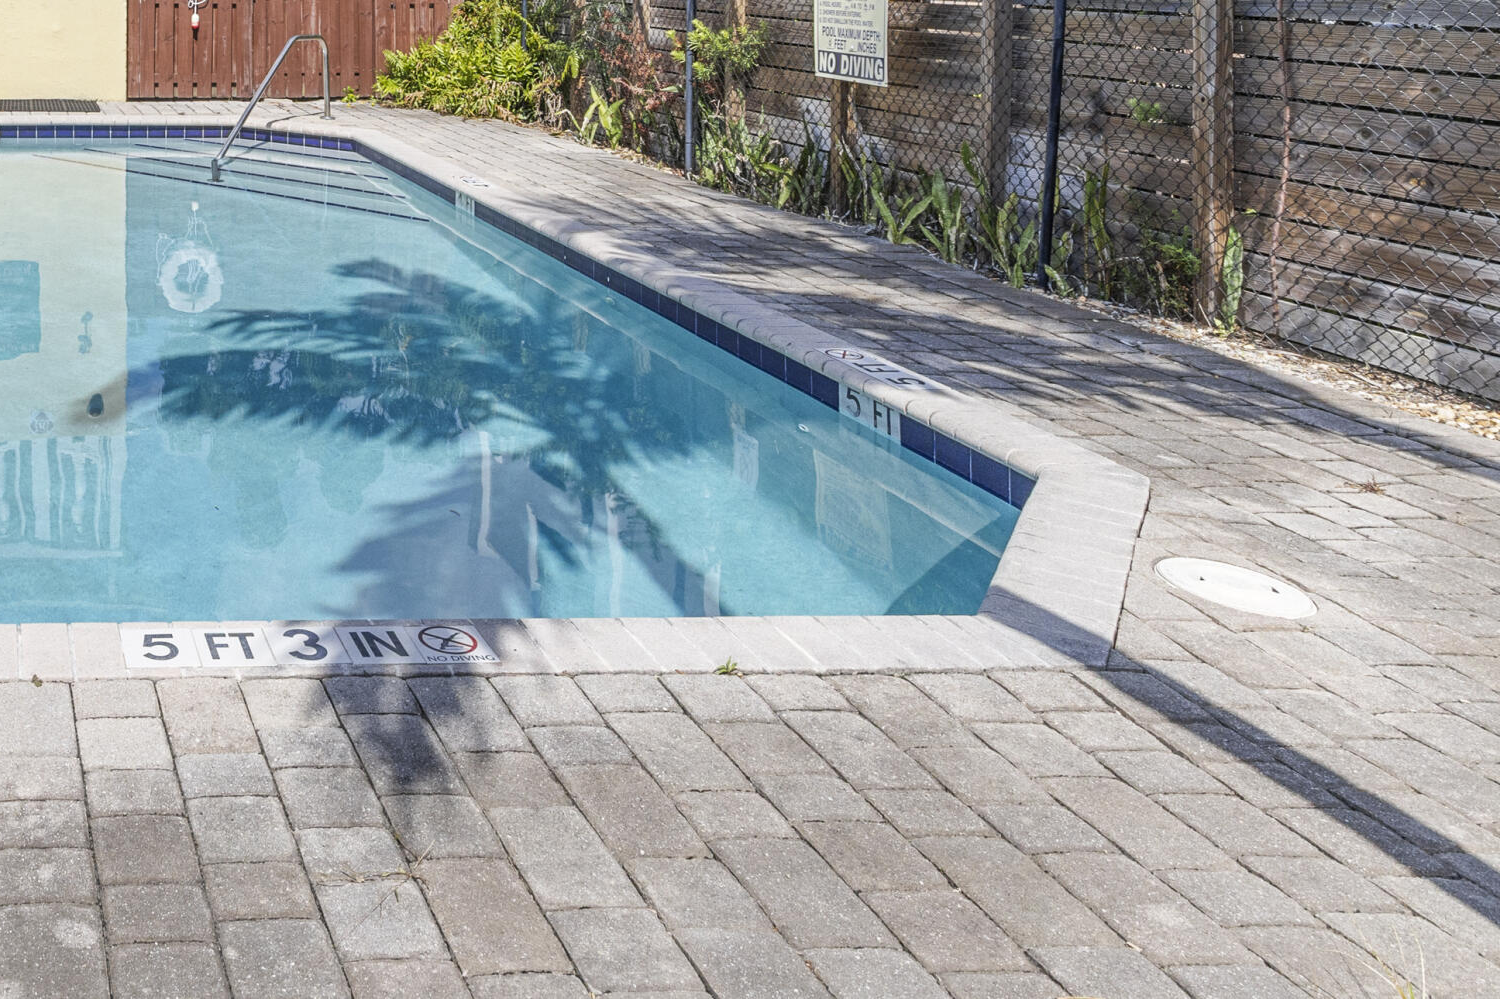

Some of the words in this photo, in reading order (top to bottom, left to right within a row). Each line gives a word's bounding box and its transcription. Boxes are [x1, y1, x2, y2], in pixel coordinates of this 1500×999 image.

[822, 26, 836, 38] POOL
[838, 27, 862, 40] MAXIMUM
[834, 38, 847, 50] FEET
[858, 42, 877, 54] INCHES
[819, 52, 836, 73] NO
[840, 54, 884, 80] DIVING
[852, 362, 900, 373] FT
[888, 377, 926, 386] 5
[846, 387, 861, 418] 5
[873, 400, 894, 436] FT
[142, 633, 180, 661] 5
[204, 632, 255, 660] FT
[282, 628, 328, 661] 3
[348, 631, 409, 658] IN
